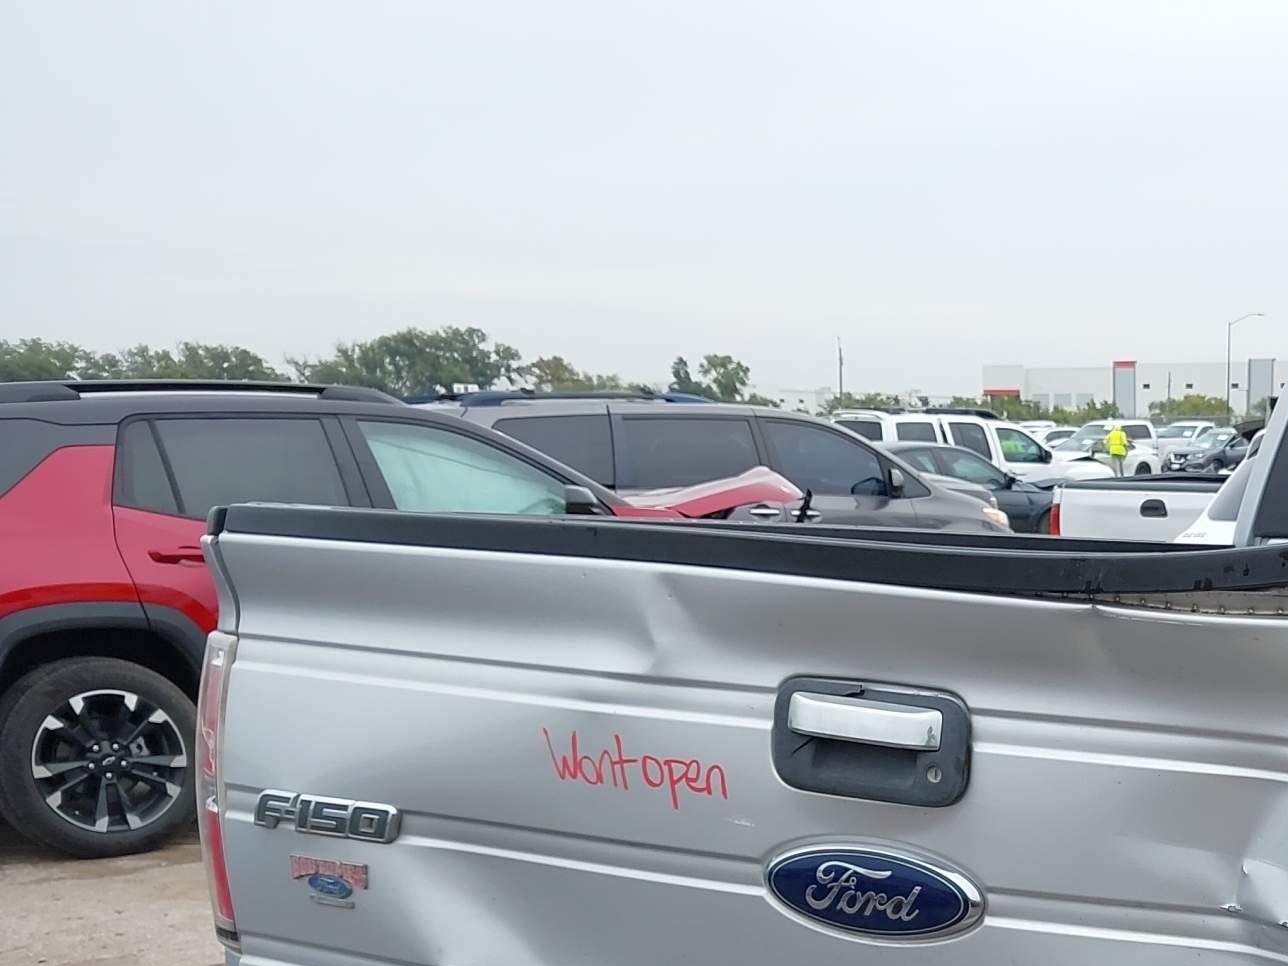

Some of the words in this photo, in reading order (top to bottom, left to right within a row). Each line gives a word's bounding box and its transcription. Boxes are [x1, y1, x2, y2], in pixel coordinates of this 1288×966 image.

[642, 755, 728, 810] open
[254, 788, 401, 844] F-150
[805, 861, 923, 922] Ford
